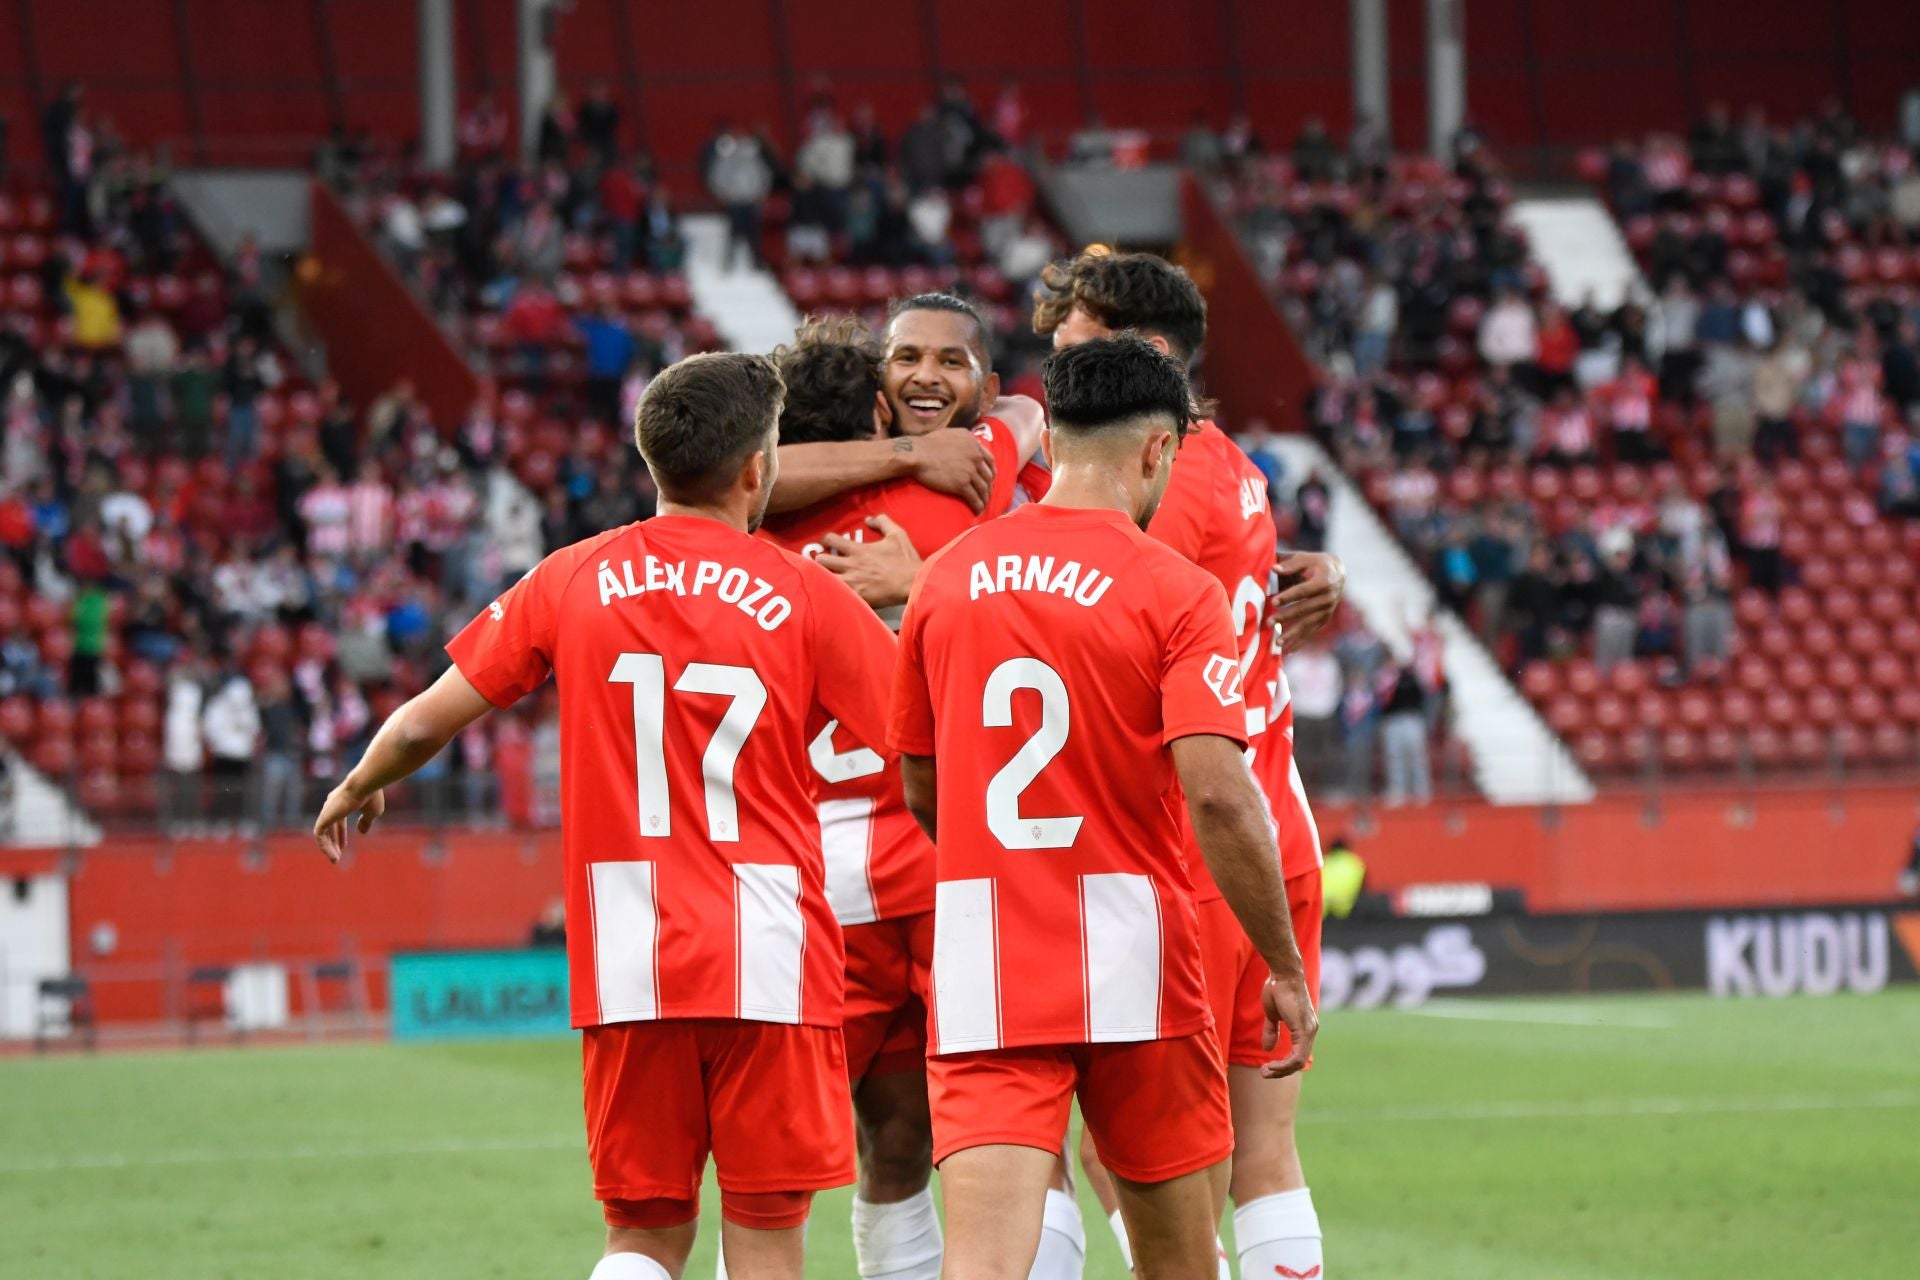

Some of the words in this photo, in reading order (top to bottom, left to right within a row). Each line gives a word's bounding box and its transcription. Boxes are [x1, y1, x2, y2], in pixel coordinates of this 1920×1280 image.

[597, 555, 687, 607] ÁLEX
[692, 560, 792, 631] POZO
[969, 554, 1114, 607] ARNAU
[607, 652, 768, 842] 17
[982, 656, 1085, 850] 2
[1706, 911, 1890, 999] KUDU
